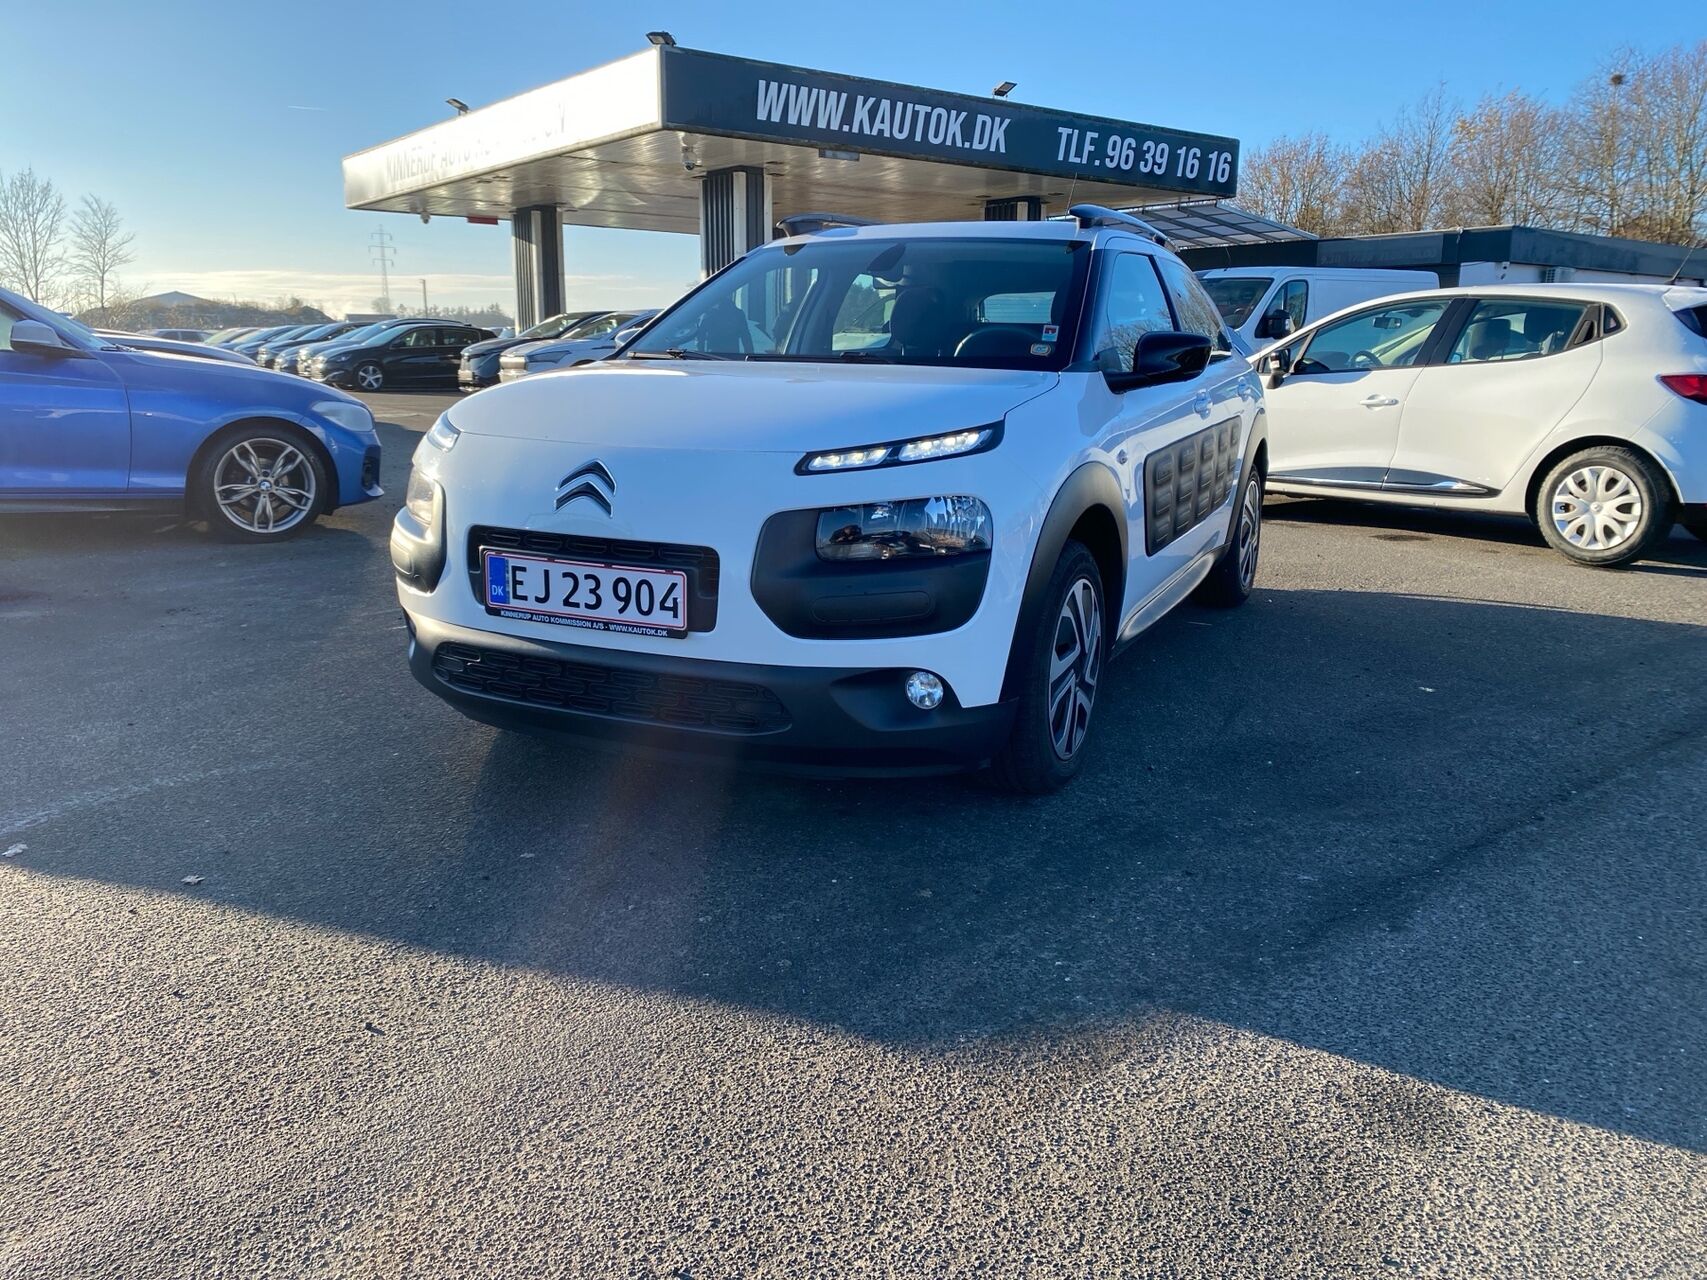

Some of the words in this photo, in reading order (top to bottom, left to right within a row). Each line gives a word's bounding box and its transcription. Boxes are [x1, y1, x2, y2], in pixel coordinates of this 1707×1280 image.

[756, 80, 1012, 154] WWW.KAUTOK.DK
[1057, 126, 1100, 166] TLF.
[1105, 135, 1137, 171] 96
[1139, 140, 1169, 175] 39
[1176, 146, 1201, 179] 16
[1208, 150, 1232, 183] 16
[491, 585, 504, 597] DK
[511, 565, 550, 604] EJ
[562, 572, 602, 610] 23
[612, 577, 679, 618] 904
[500, 610, 531, 620] KINNERUP
[532, 614, 550, 623] AUTO
[550, 617, 592, 628] KOMMISSION
[592, 622, 604, 630] A/S
[608, 624, 668, 637] WWW.KAUTOK.DK
